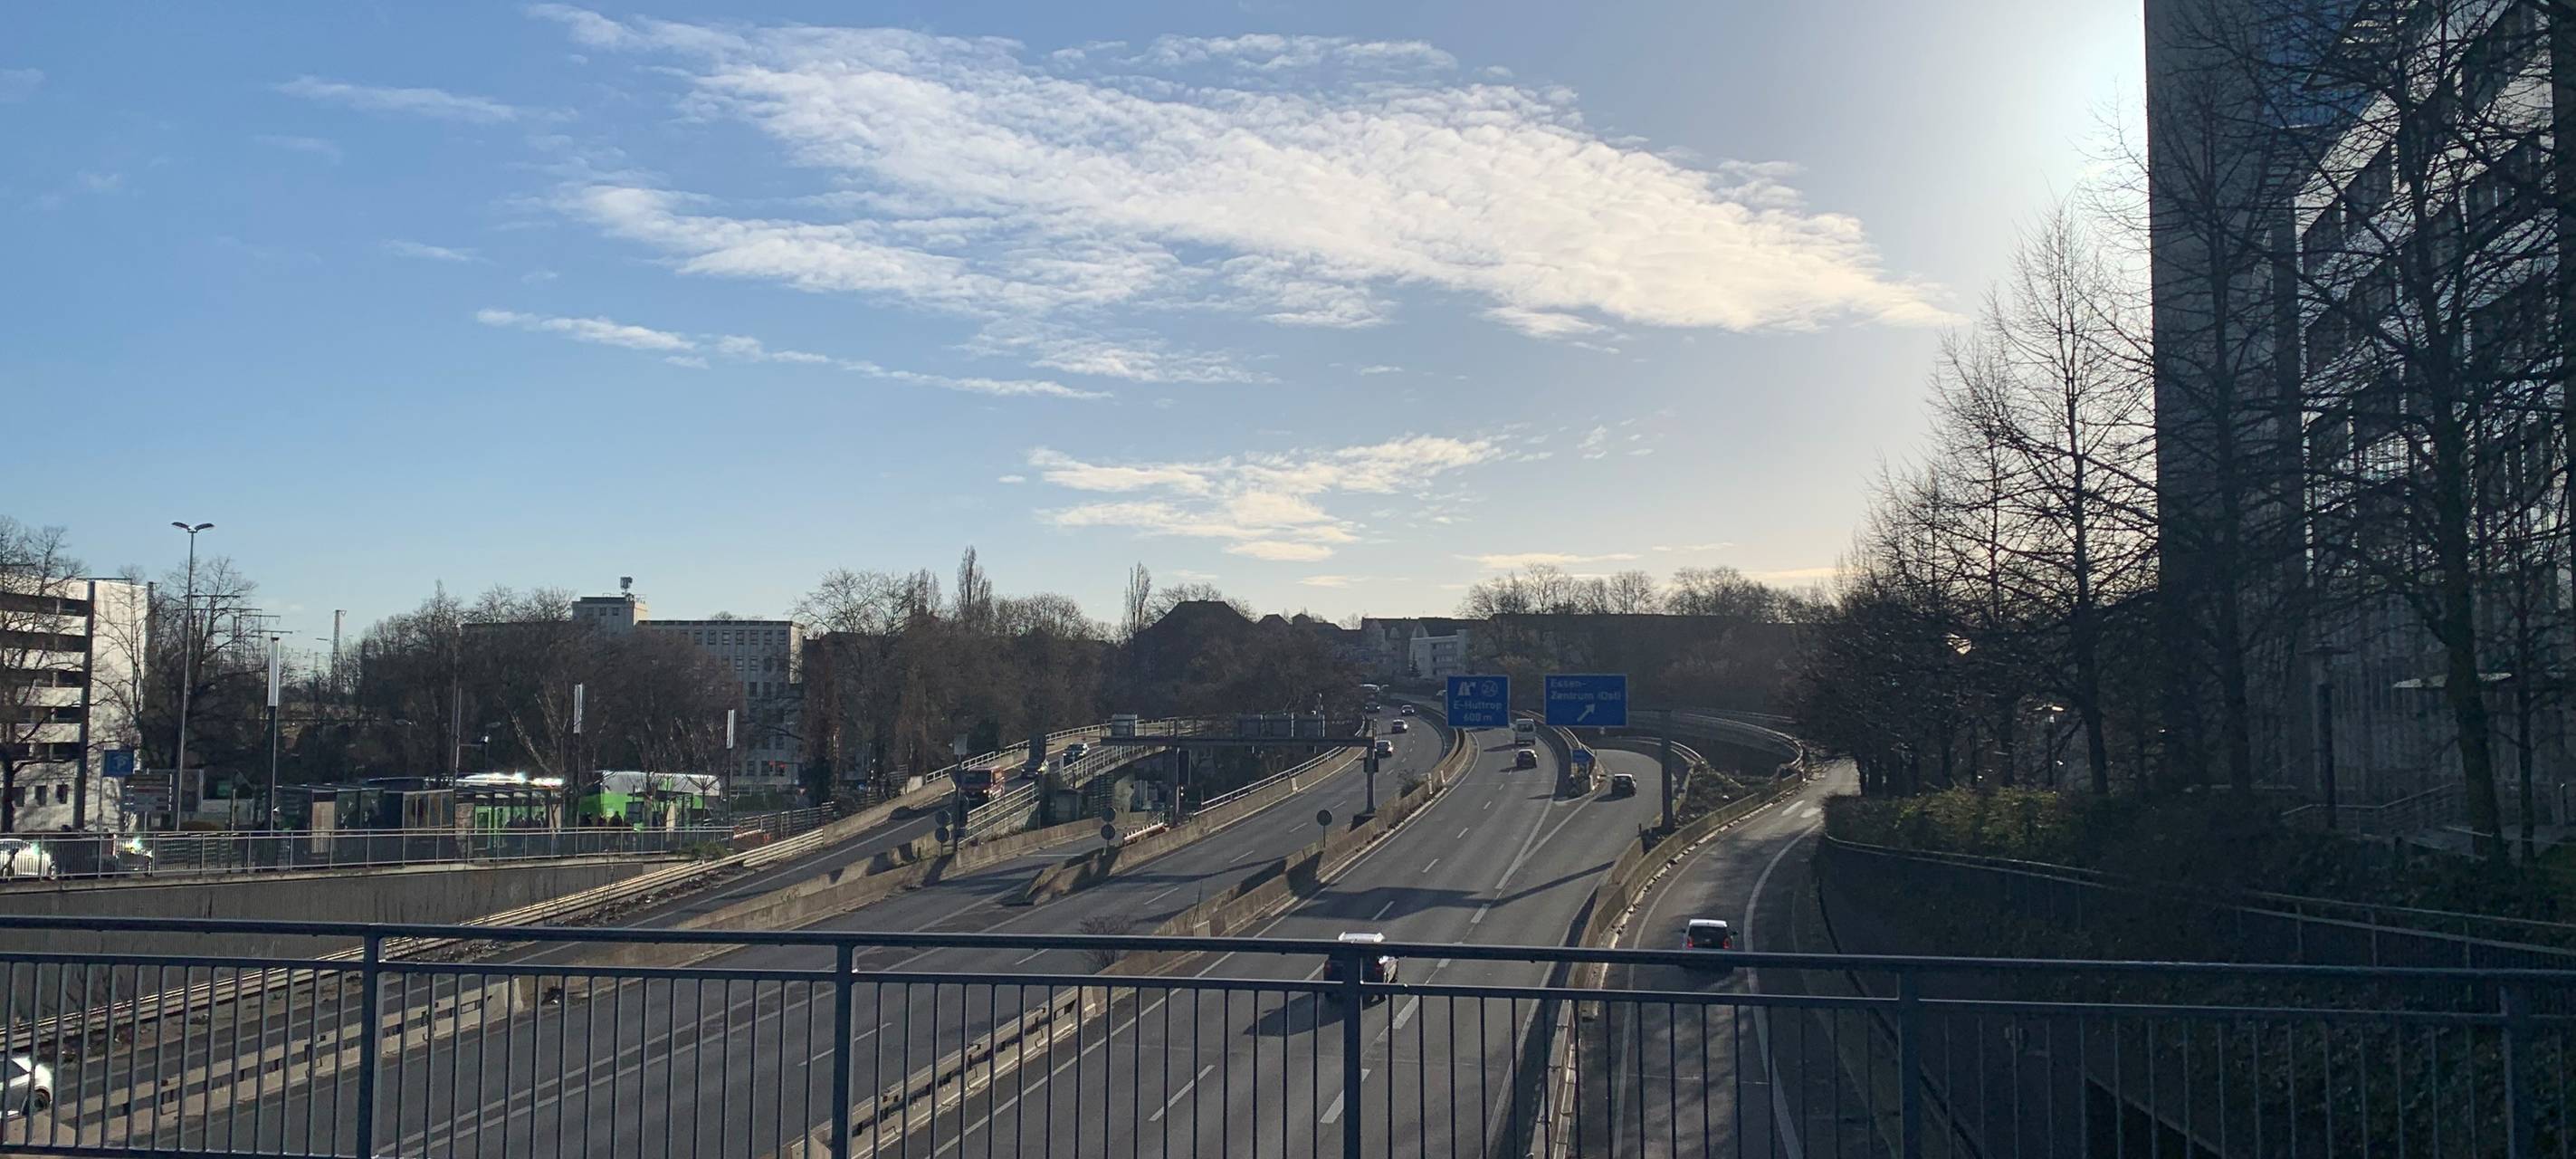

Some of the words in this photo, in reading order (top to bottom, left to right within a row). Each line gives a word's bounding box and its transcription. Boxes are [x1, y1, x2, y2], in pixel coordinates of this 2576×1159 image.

[1550, 690, 1594, 700] Zentrum
[1453, 700, 1503, 711] E-Huttrop
[1484, 714, 1493, 723] m
